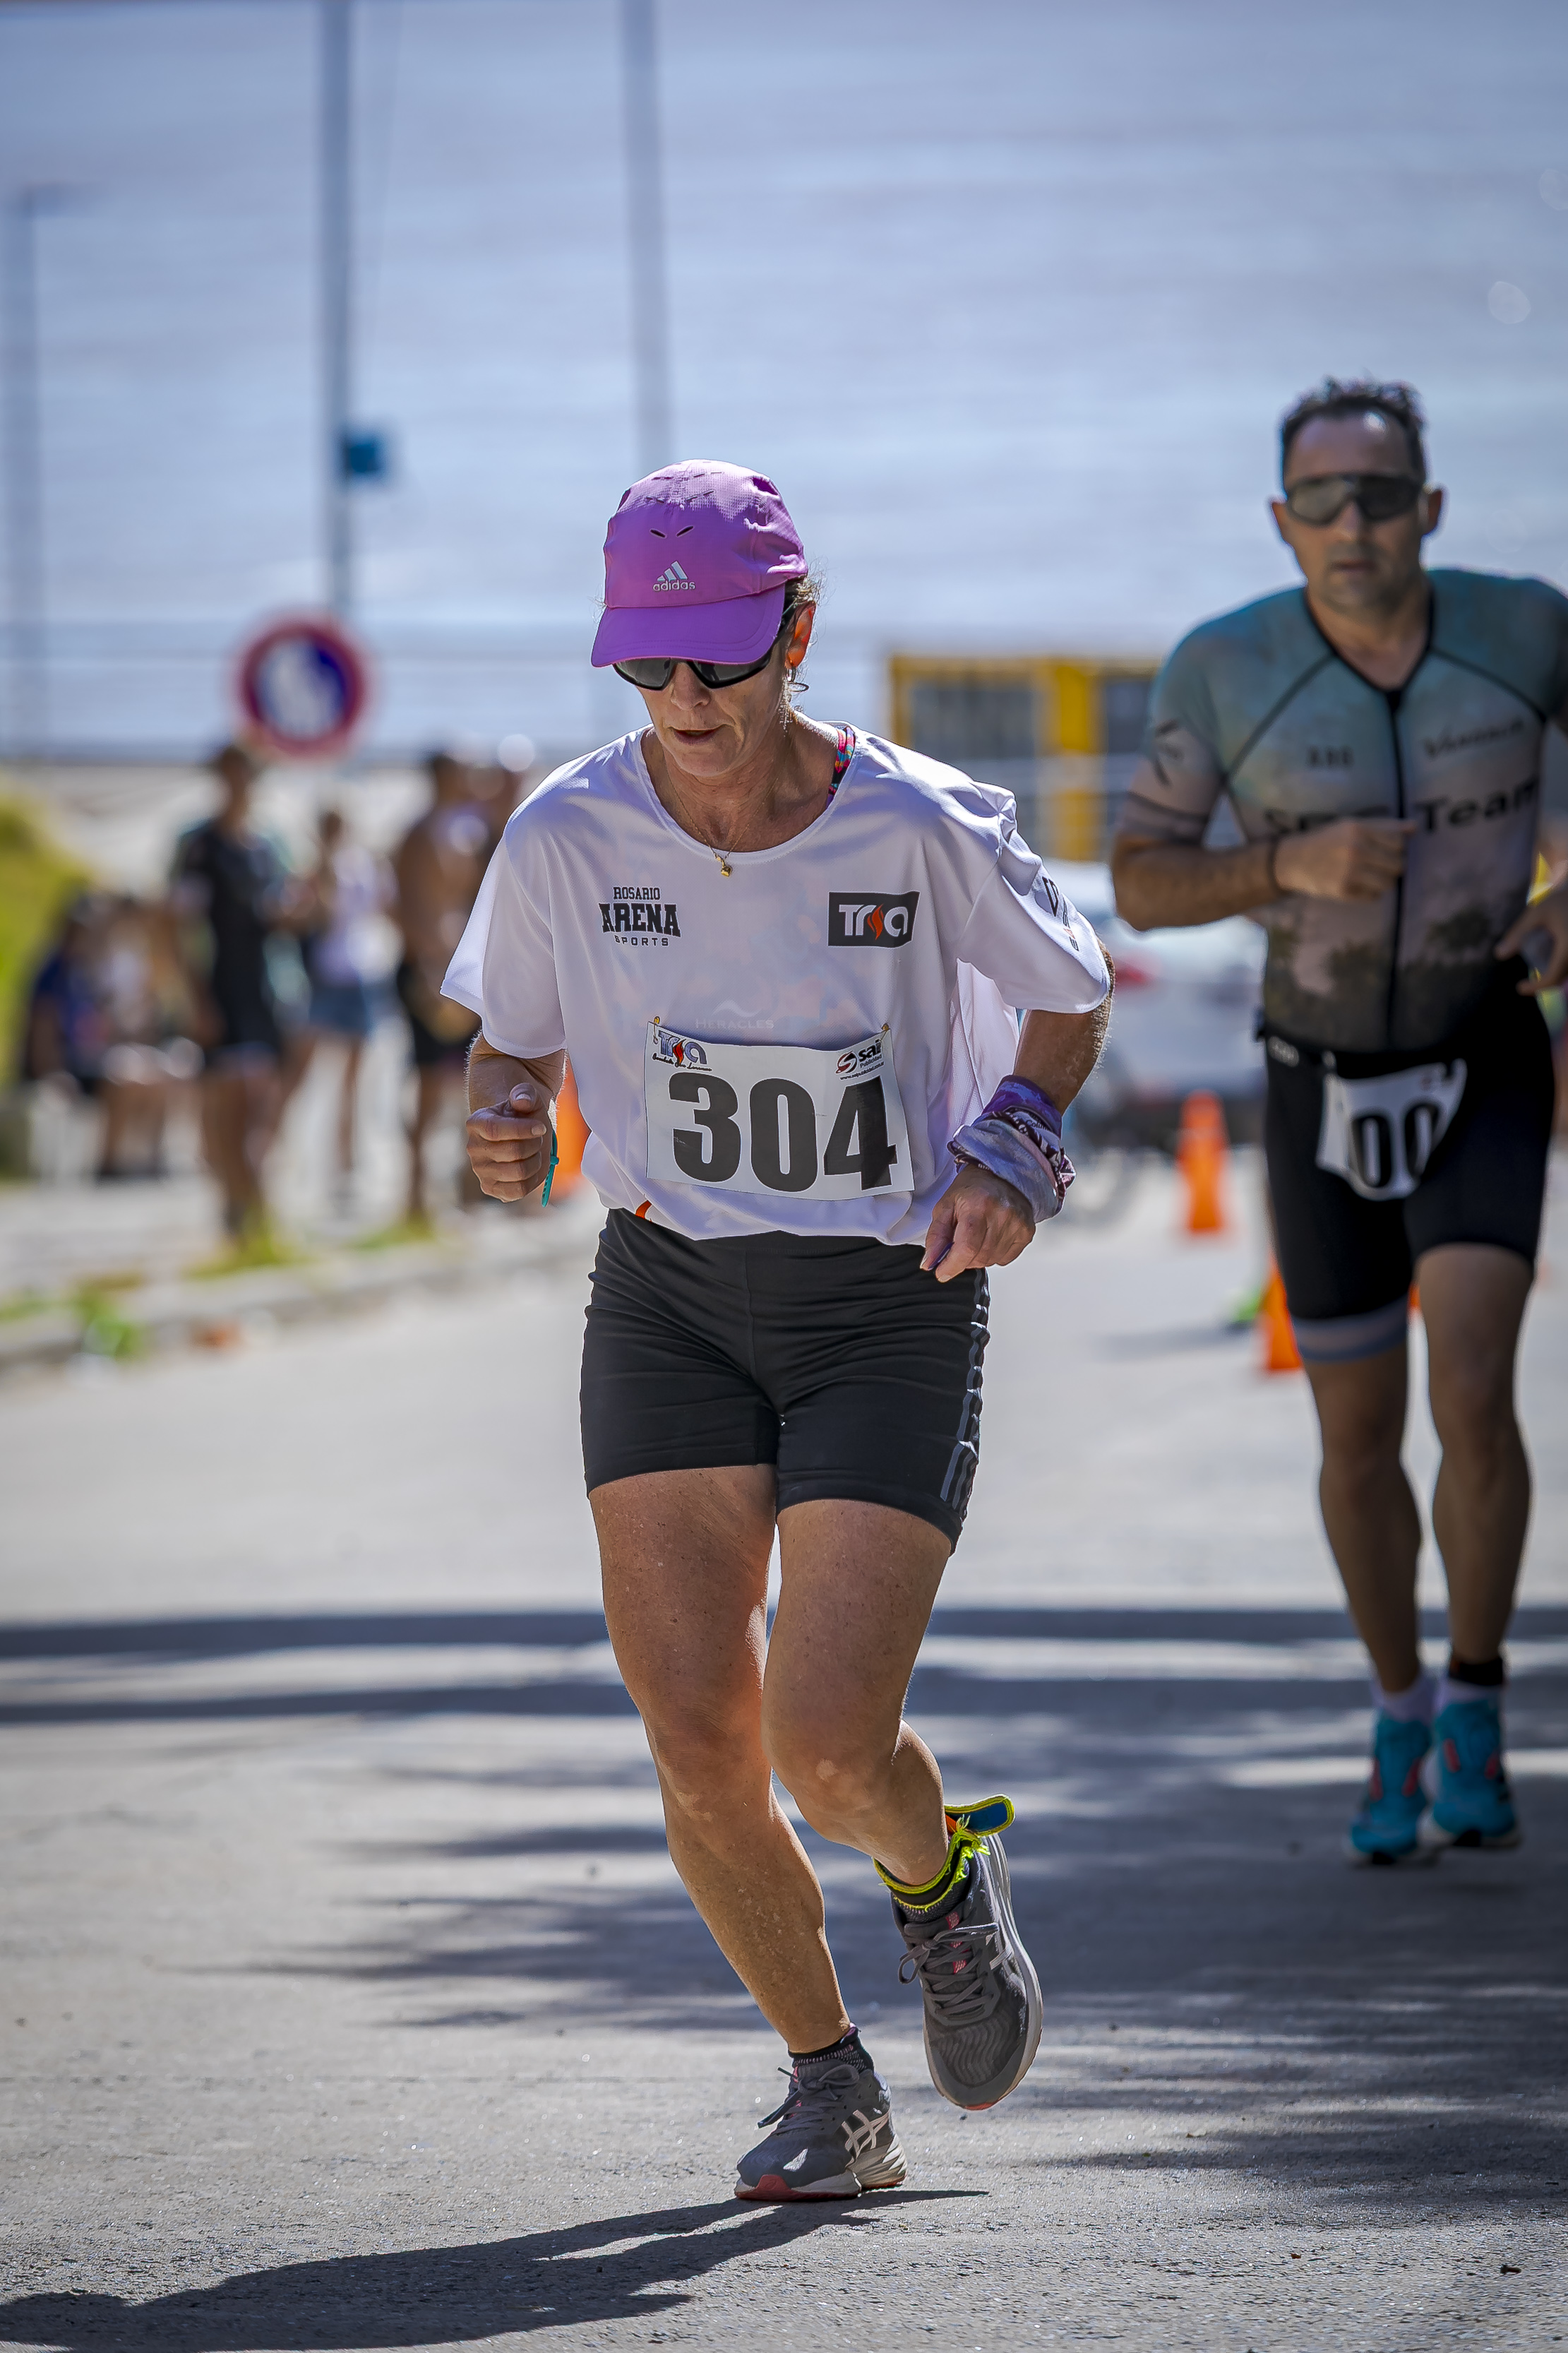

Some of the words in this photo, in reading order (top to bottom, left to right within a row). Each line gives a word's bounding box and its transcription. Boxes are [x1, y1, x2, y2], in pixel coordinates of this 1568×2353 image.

[652, 580, 695, 592] adidas
[613, 886, 661, 900] ROSARIO
[598, 903, 681, 938] ARENA
[614, 934, 669, 946] SPORTS
[695, 1018, 774, 1030] HERACLES
[669, 1072, 898, 1192] 304
